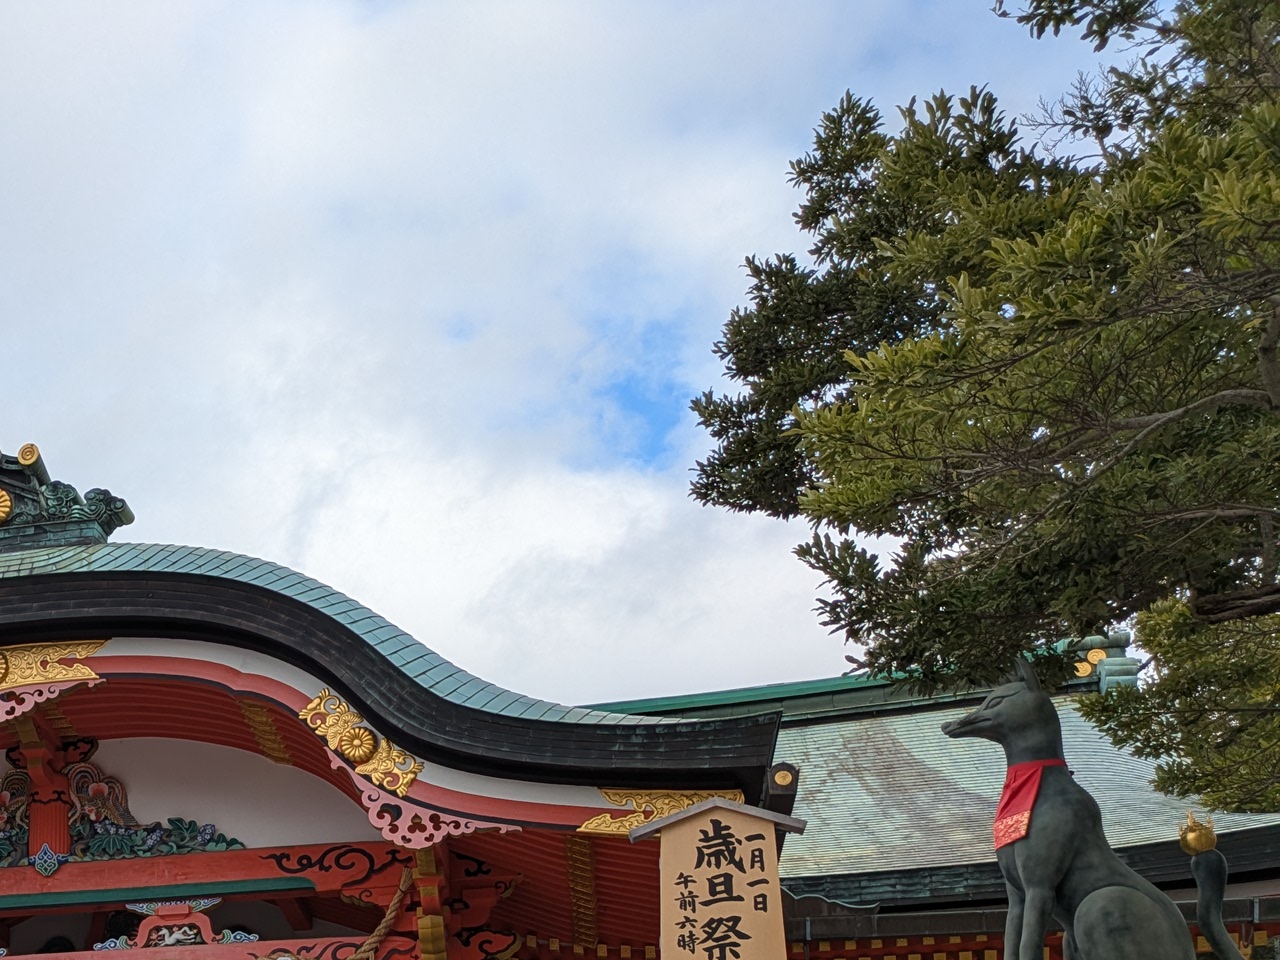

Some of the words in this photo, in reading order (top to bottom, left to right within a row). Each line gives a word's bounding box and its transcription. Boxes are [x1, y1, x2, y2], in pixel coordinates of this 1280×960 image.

[674, 872, 700, 955] 午前六時
[744, 833, 770, 913] 一月一日
